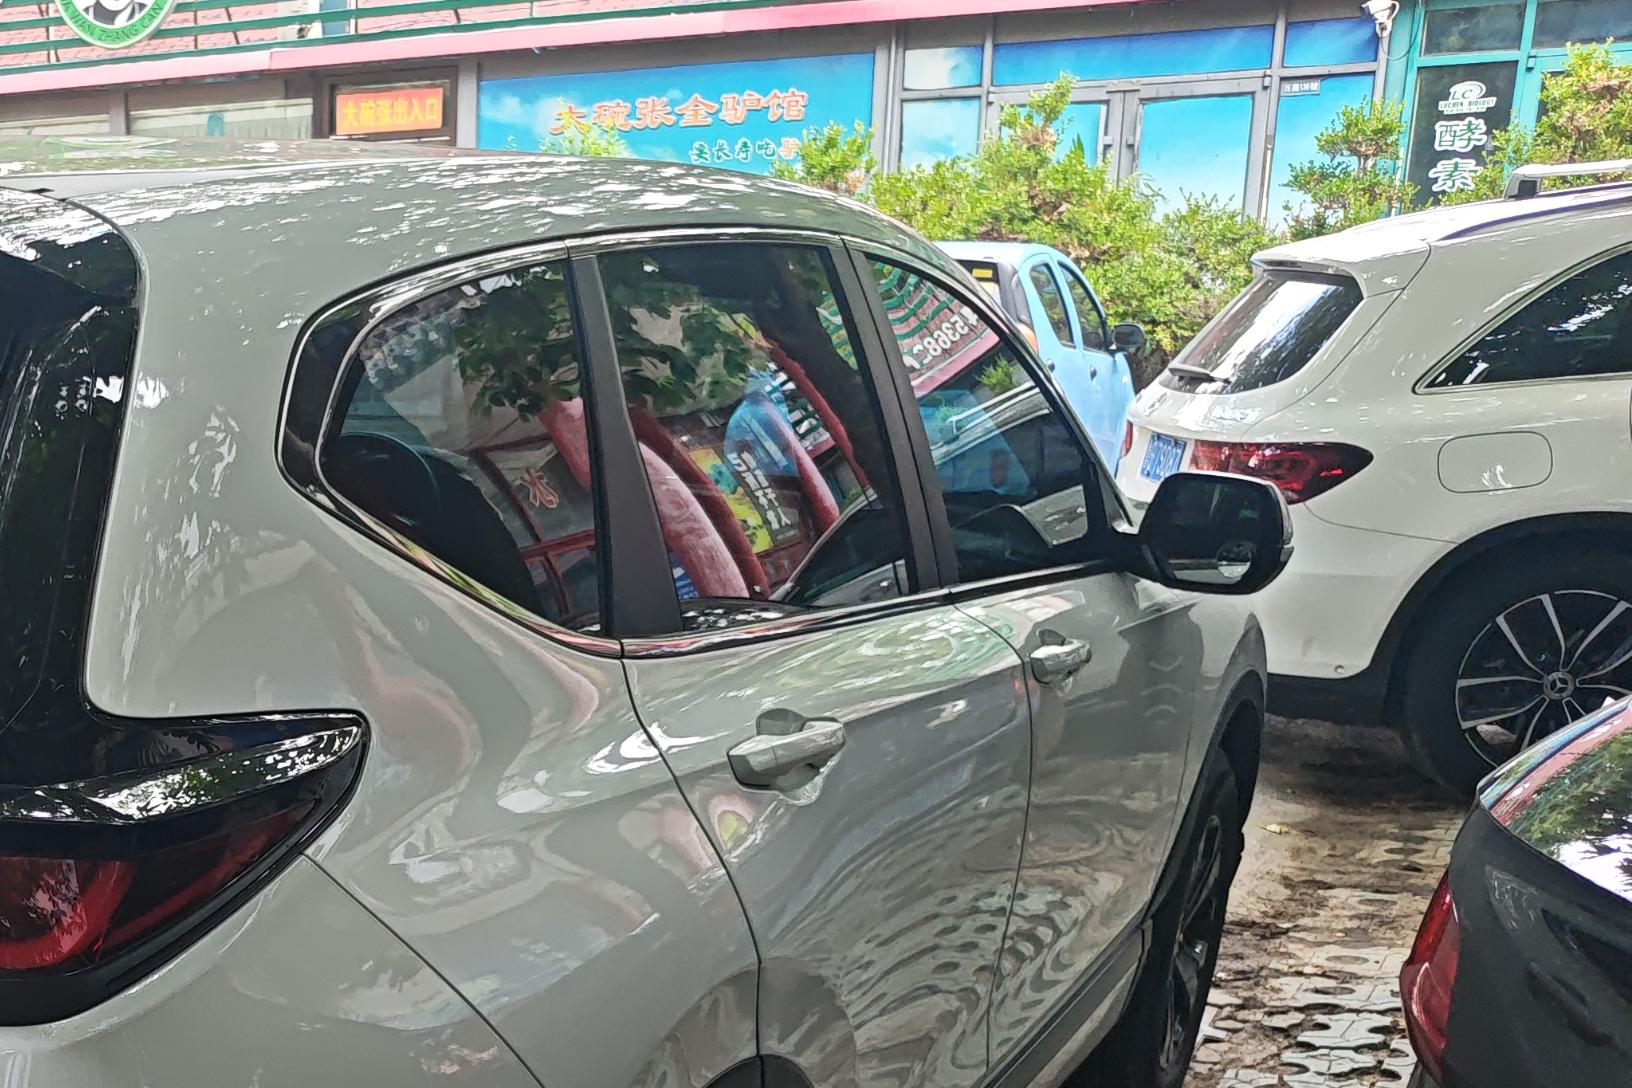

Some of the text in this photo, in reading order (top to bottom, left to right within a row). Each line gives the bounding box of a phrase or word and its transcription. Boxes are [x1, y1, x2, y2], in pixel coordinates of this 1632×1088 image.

[550, 88, 809, 135] 大碗张全驴馆
